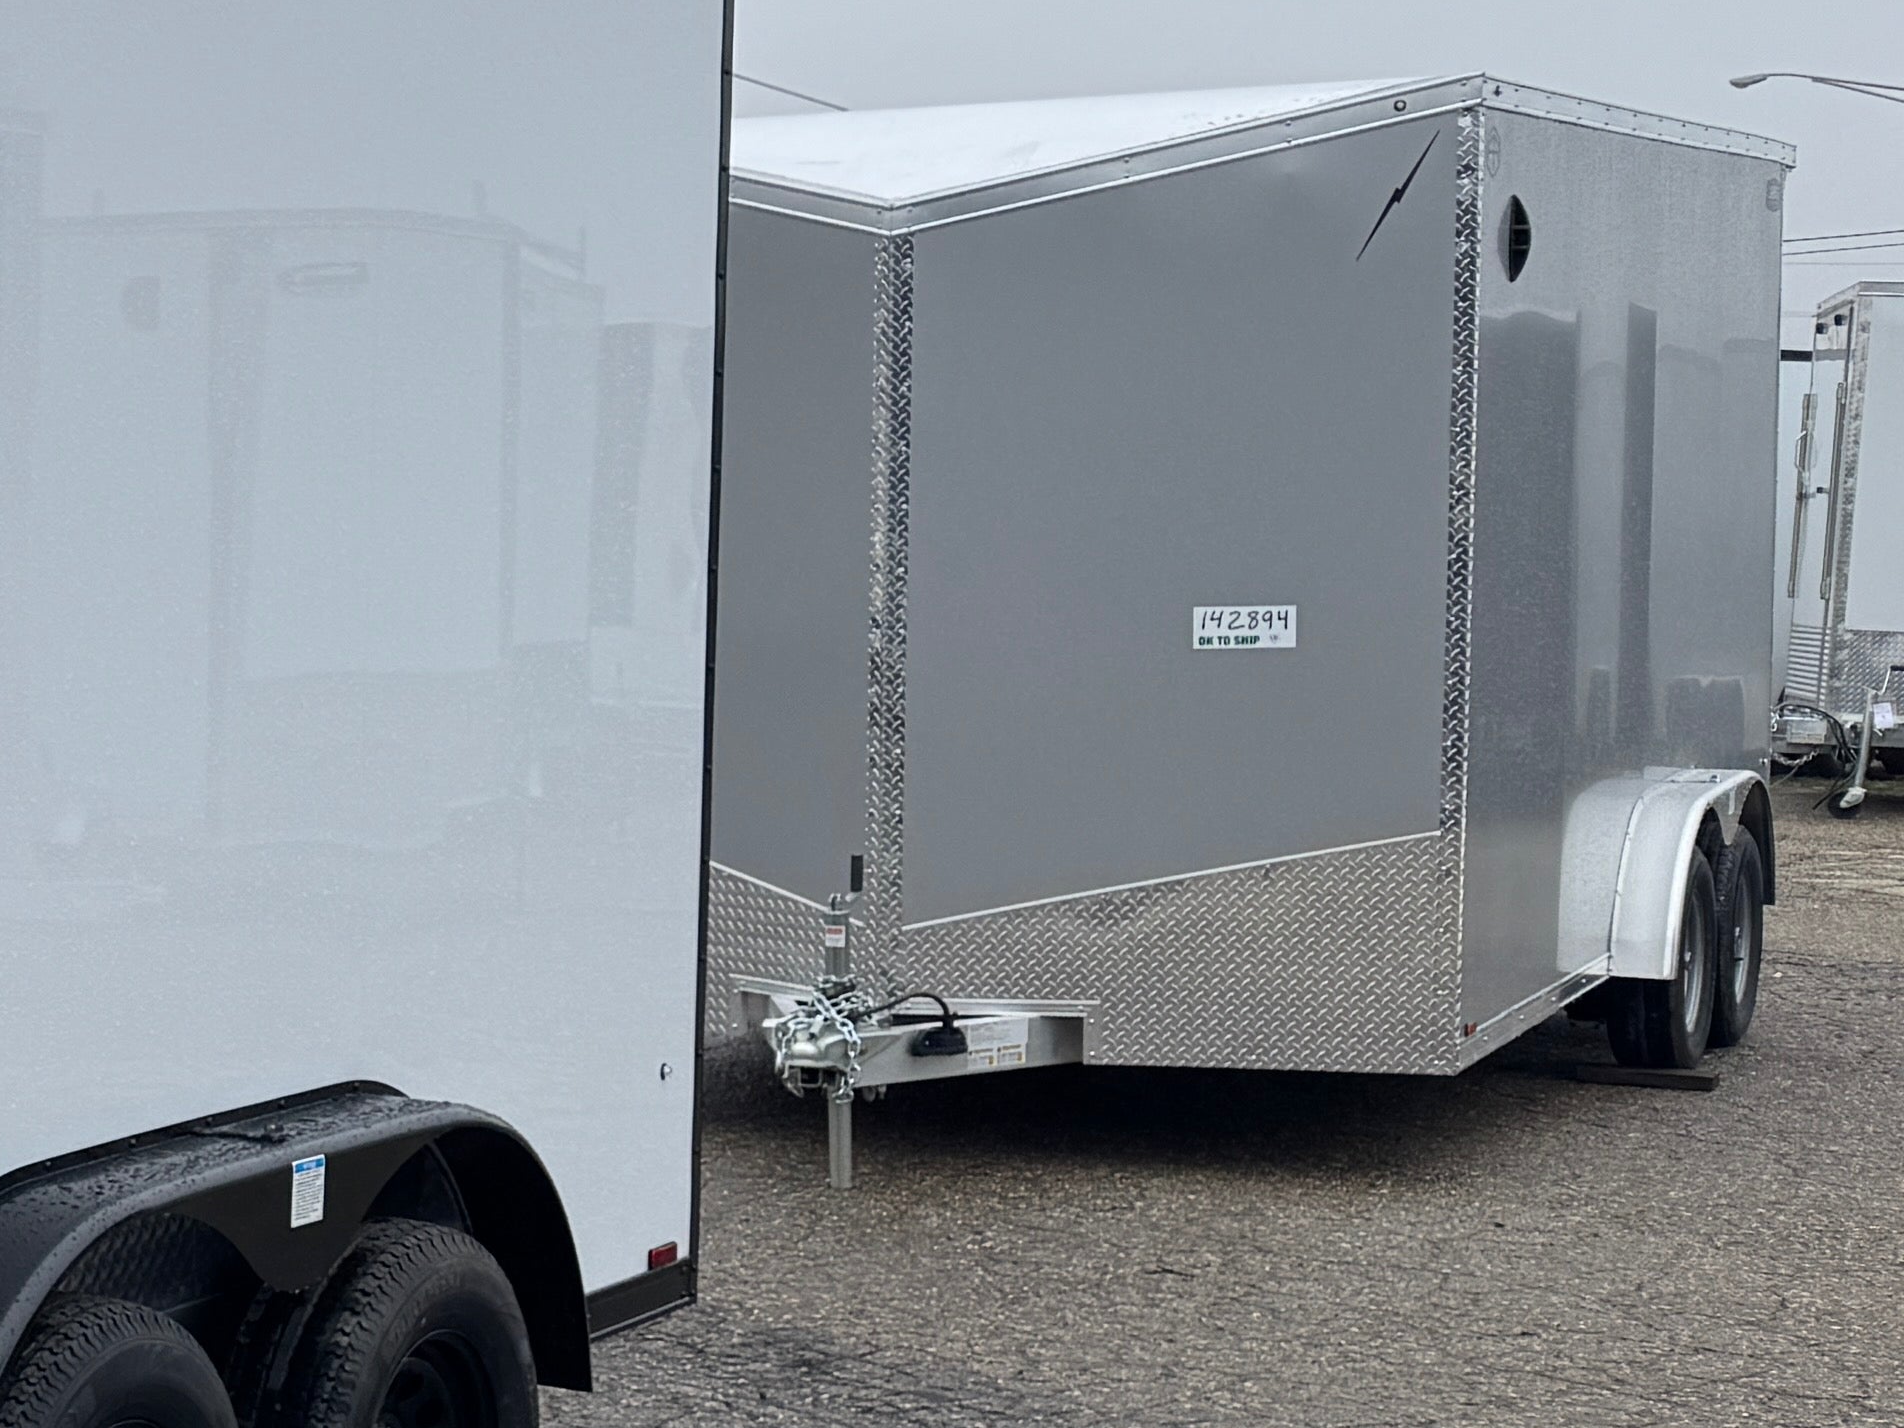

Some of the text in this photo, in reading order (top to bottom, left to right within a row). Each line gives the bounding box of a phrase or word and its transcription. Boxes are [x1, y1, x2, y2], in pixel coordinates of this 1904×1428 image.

[1201, 609, 1289, 631] 142894
[1198, 636, 1214, 646] OK
[1217, 636, 1231, 646] TO
[1234, 635, 1260, 645] SHIP
